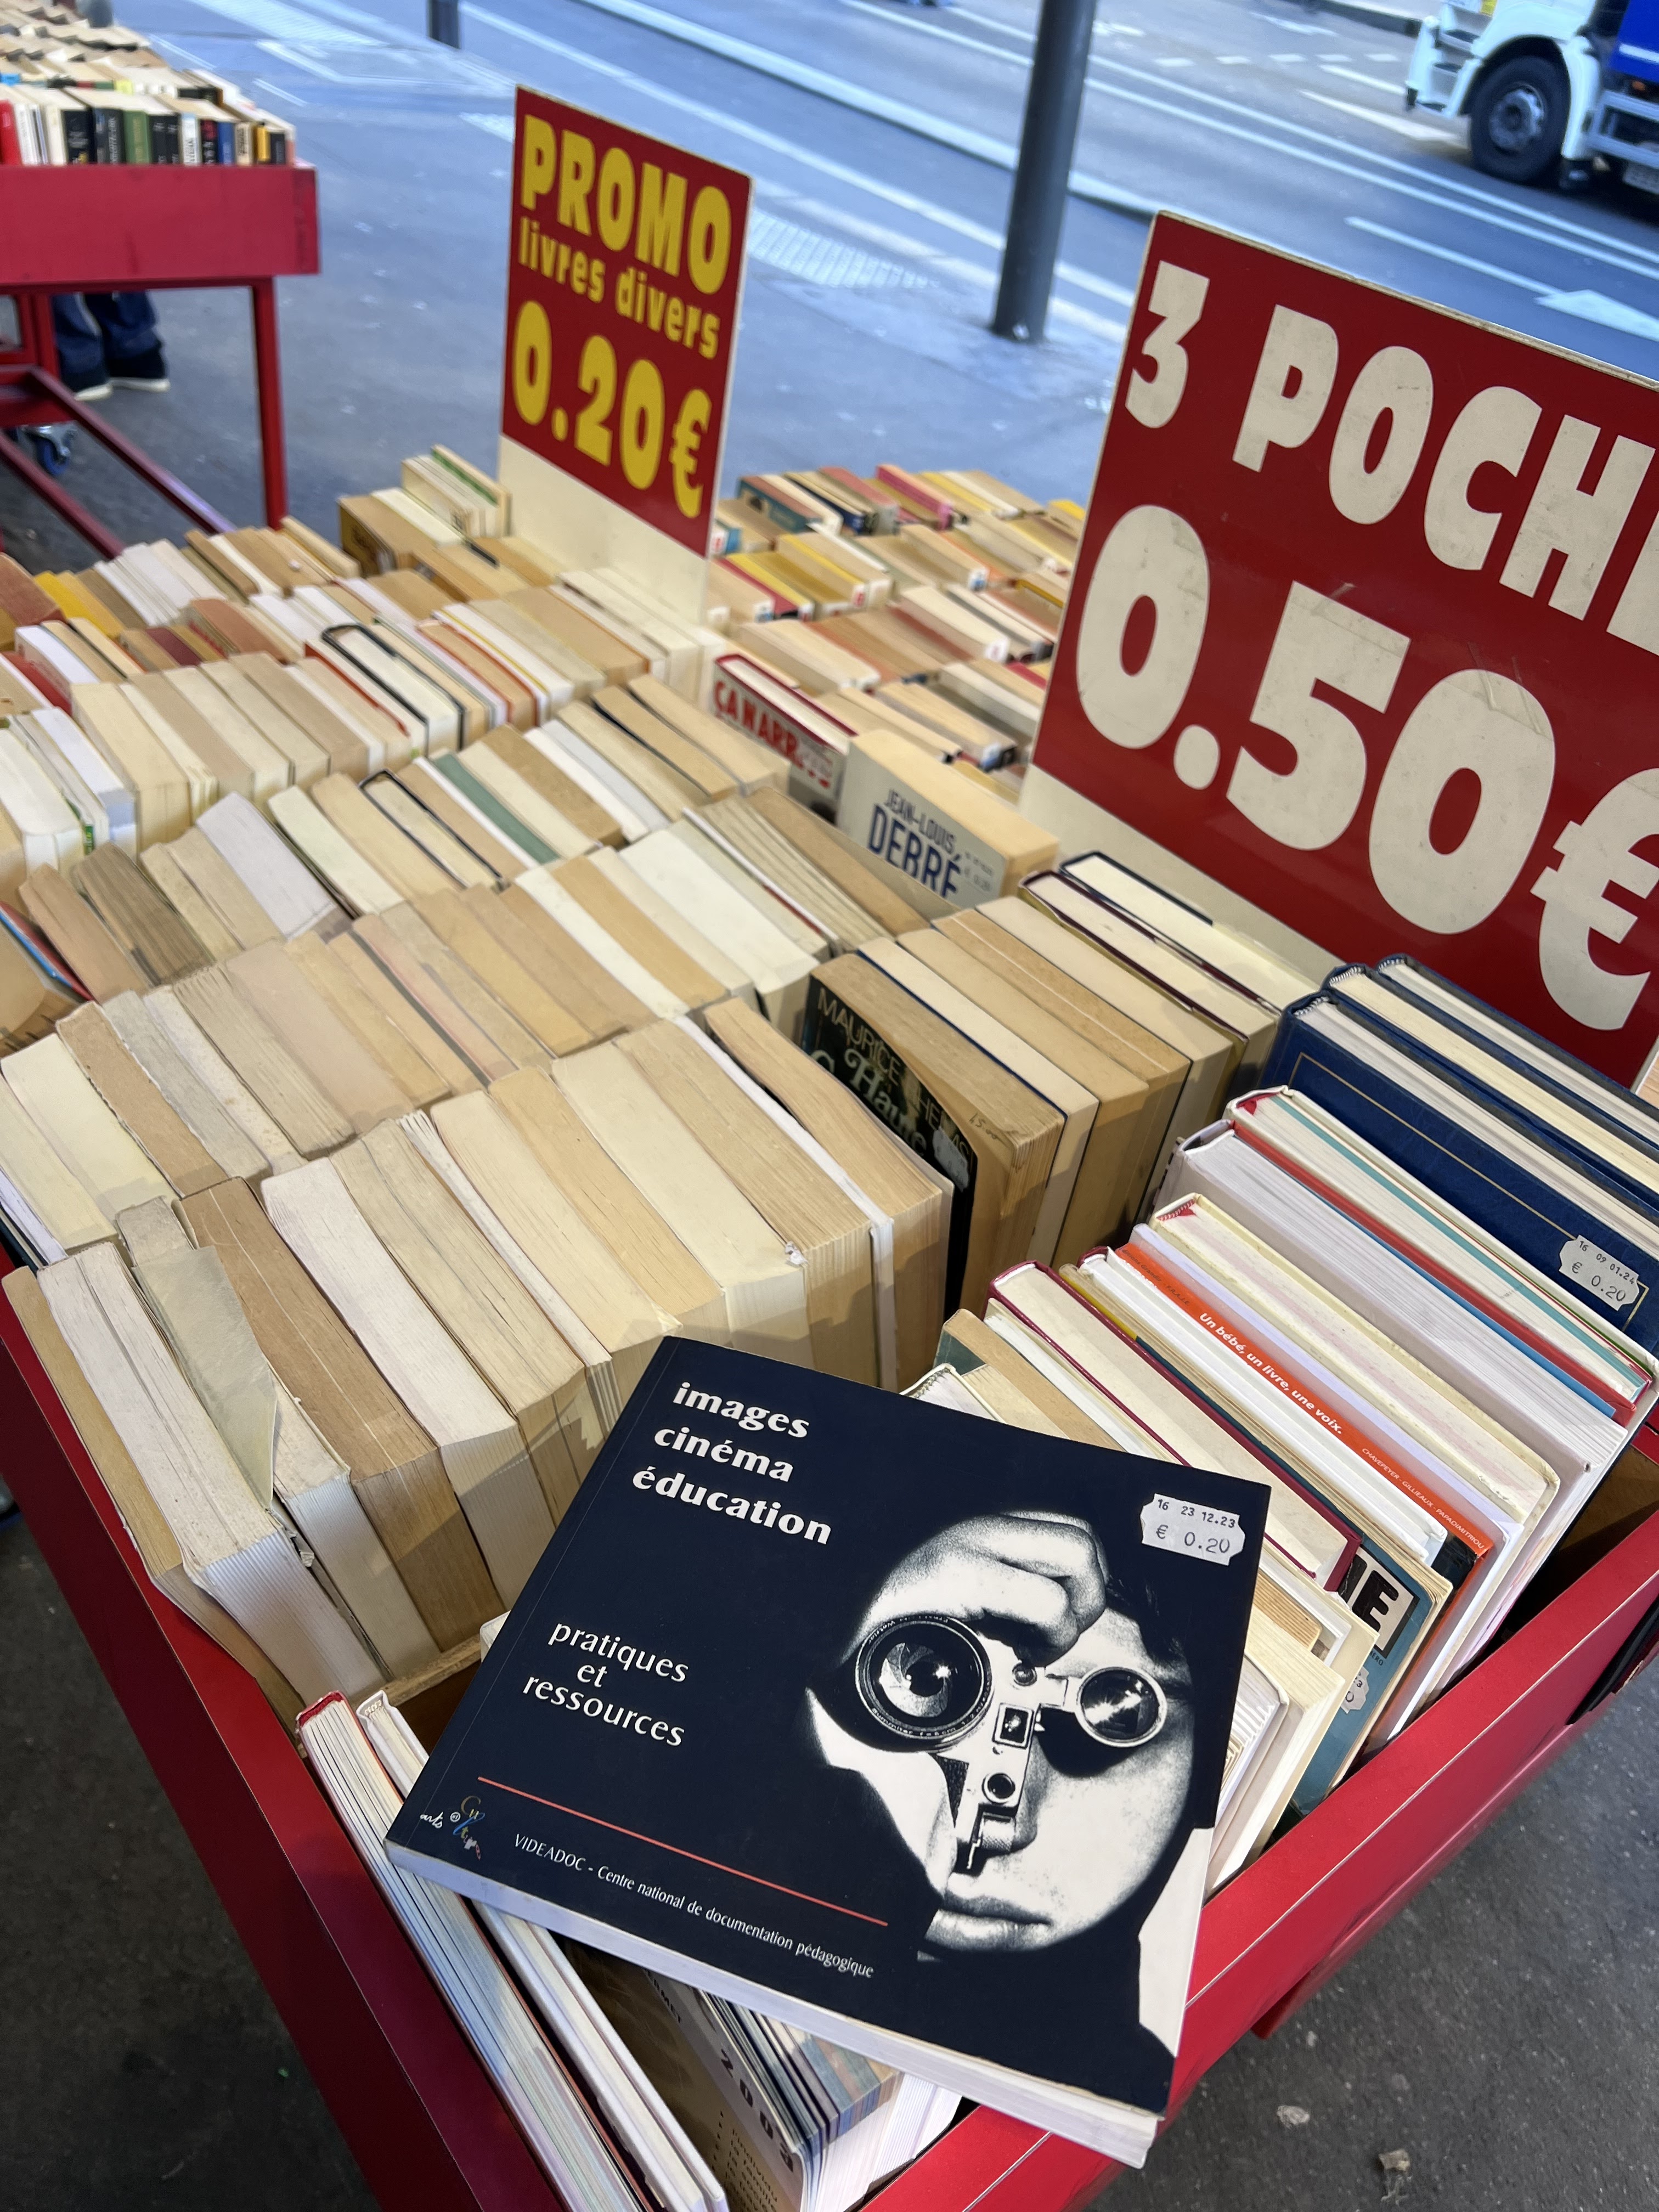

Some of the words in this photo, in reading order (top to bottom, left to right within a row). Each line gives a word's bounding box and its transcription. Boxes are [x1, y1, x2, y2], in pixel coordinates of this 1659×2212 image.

[521, 114, 732, 295] PROMO
[517, 217, 606, 303] livres
[615, 267, 721, 360] divers
[1125, 260, 1210, 429] 3
[512, 300, 713, 519] 0.20€
[1076, 504, 1659, 1030] 0.50€
[868, 804, 962, 898] DEBRÉ
[883, 789, 955, 855] JEAN-LOUIS
[817, 988, 904, 1087] MAURICE
[1571, 1261, 1583, 1274] €
[1591, 1275, 1627, 1302] 0.20
[1578, 1240, 1589, 1252] 16
[1596, 1253, 1607, 1263] 09
[1610, 1263, 1635, 1285] 01.24
[673, 1381, 810, 1438] images
[1199, 1313, 1216, 1328] Un
[1215, 1326, 1246, 1354] bébé,
[1246, 1352, 1263, 1367] un
[1262, 1365, 1289, 1391] livre,
[1291, 1390, 1315, 1410] une
[1315, 1408, 1342, 1434] voix.
[654, 1426, 794, 1482] cinéma
[633, 1465, 832, 1545] éducation
[1158, 1499, 1170, 1510] 16
[1181, 1506, 1195, 1516] 23
[1201, 1511, 1235, 1528] 12.23
[1362, 1448, 1400, 1480] CHAVEPEYER
[1402, 1481, 1434, 1507] GILLIEAUX
[1436, 1508, 1485, 1549] PAPADIMITRIOU
[1156, 1525, 1169, 1539] €
[1184, 1532, 1230, 1554] 0.20
[548, 1623, 689, 1683] pratiques
[576, 1663, 608, 1688] et
[523, 1676, 685, 1747] ressources
[420, 1811, 444, 1829] arts
[514, 1833, 586, 1872] VIDEADOC
[597, 1866, 635, 1891] Centre
[637, 1881, 686, 1910] national
[687, 1900, 703, 1916] de
[706, 1907, 794, 1950] documentation
[795, 1941, 874, 1979] pédagogique
